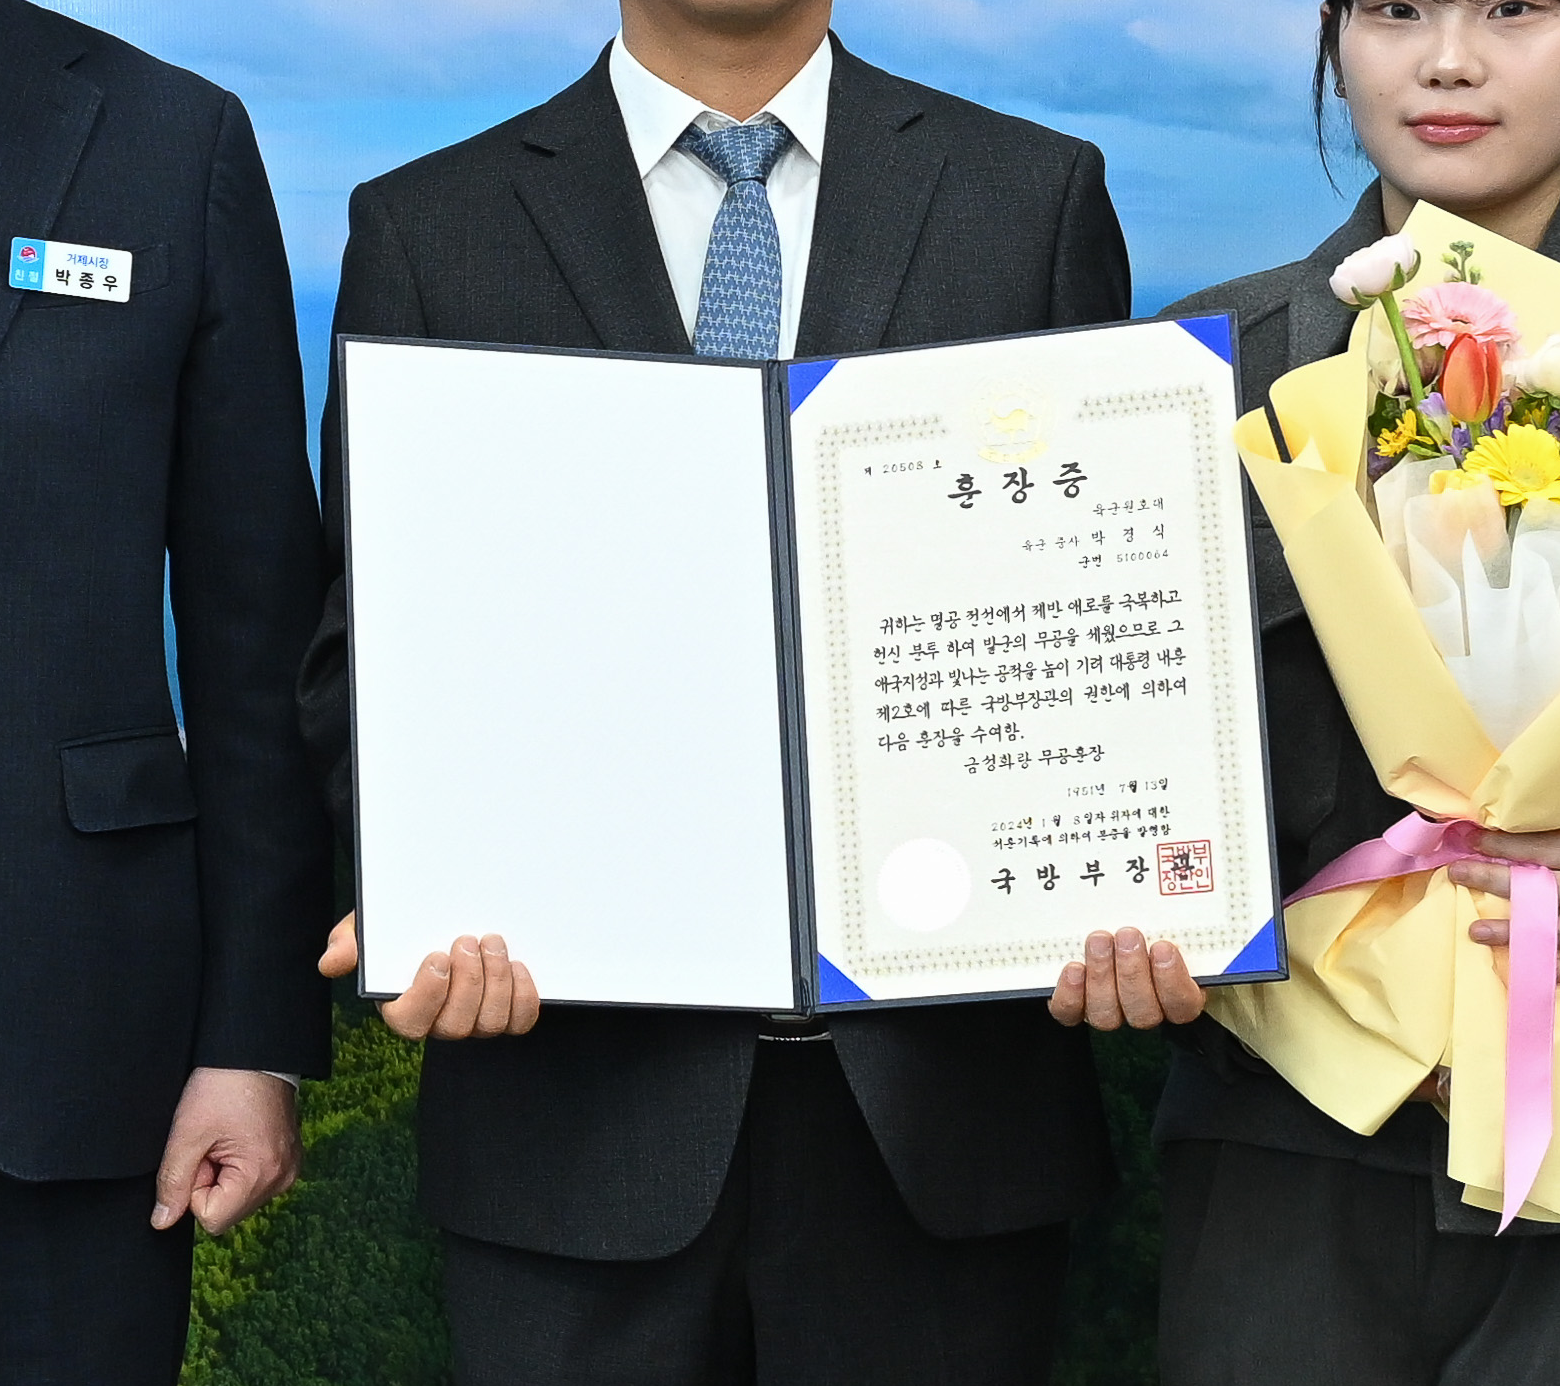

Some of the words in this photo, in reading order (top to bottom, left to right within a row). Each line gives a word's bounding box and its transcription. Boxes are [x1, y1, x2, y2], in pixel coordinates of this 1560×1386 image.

[56, 268, 117, 291] 박종우
[948, 462, 1088, 509] 훈장증
[879, 614, 926, 636] 귀하는
[965, 603, 1026, 628] 전선에서
[1031, 599, 1064, 620] 제반
[1067, 594, 1115, 617] 애로를
[1118, 589, 1183, 612] 극복하고
[873, 644, 900, 666] 헌신
[908, 641, 940, 662] 분투
[946, 638, 975, 659] 하여
[983, 632, 1027, 655] 발군의
[1033, 627, 1080, 650] 무공을
[1086, 620, 1162, 645] 세웠으므로
[1167, 619, 1185, 633] 그
[874, 670, 945, 694] 애국지성과
[948, 667, 991, 688] 빛나는
[993, 661, 1038, 684] 공적을
[1076, 654, 1103, 675] 기려
[1109, 649, 1150, 672] 대통령
[876, 700, 931, 724] 제2호에
[941, 697, 972, 718] 따른
[980, 686, 1073, 714] 국방부장관의
[1083, 681, 1130, 704] 권한에
[1141, 676, 1187, 699] 의하여
[878, 731, 910, 753] 다음
[915, 726, 965, 749] 훈장을
[970, 721, 1025, 744] 수여함.
[1037, 744, 1105, 766] 무공훈장
